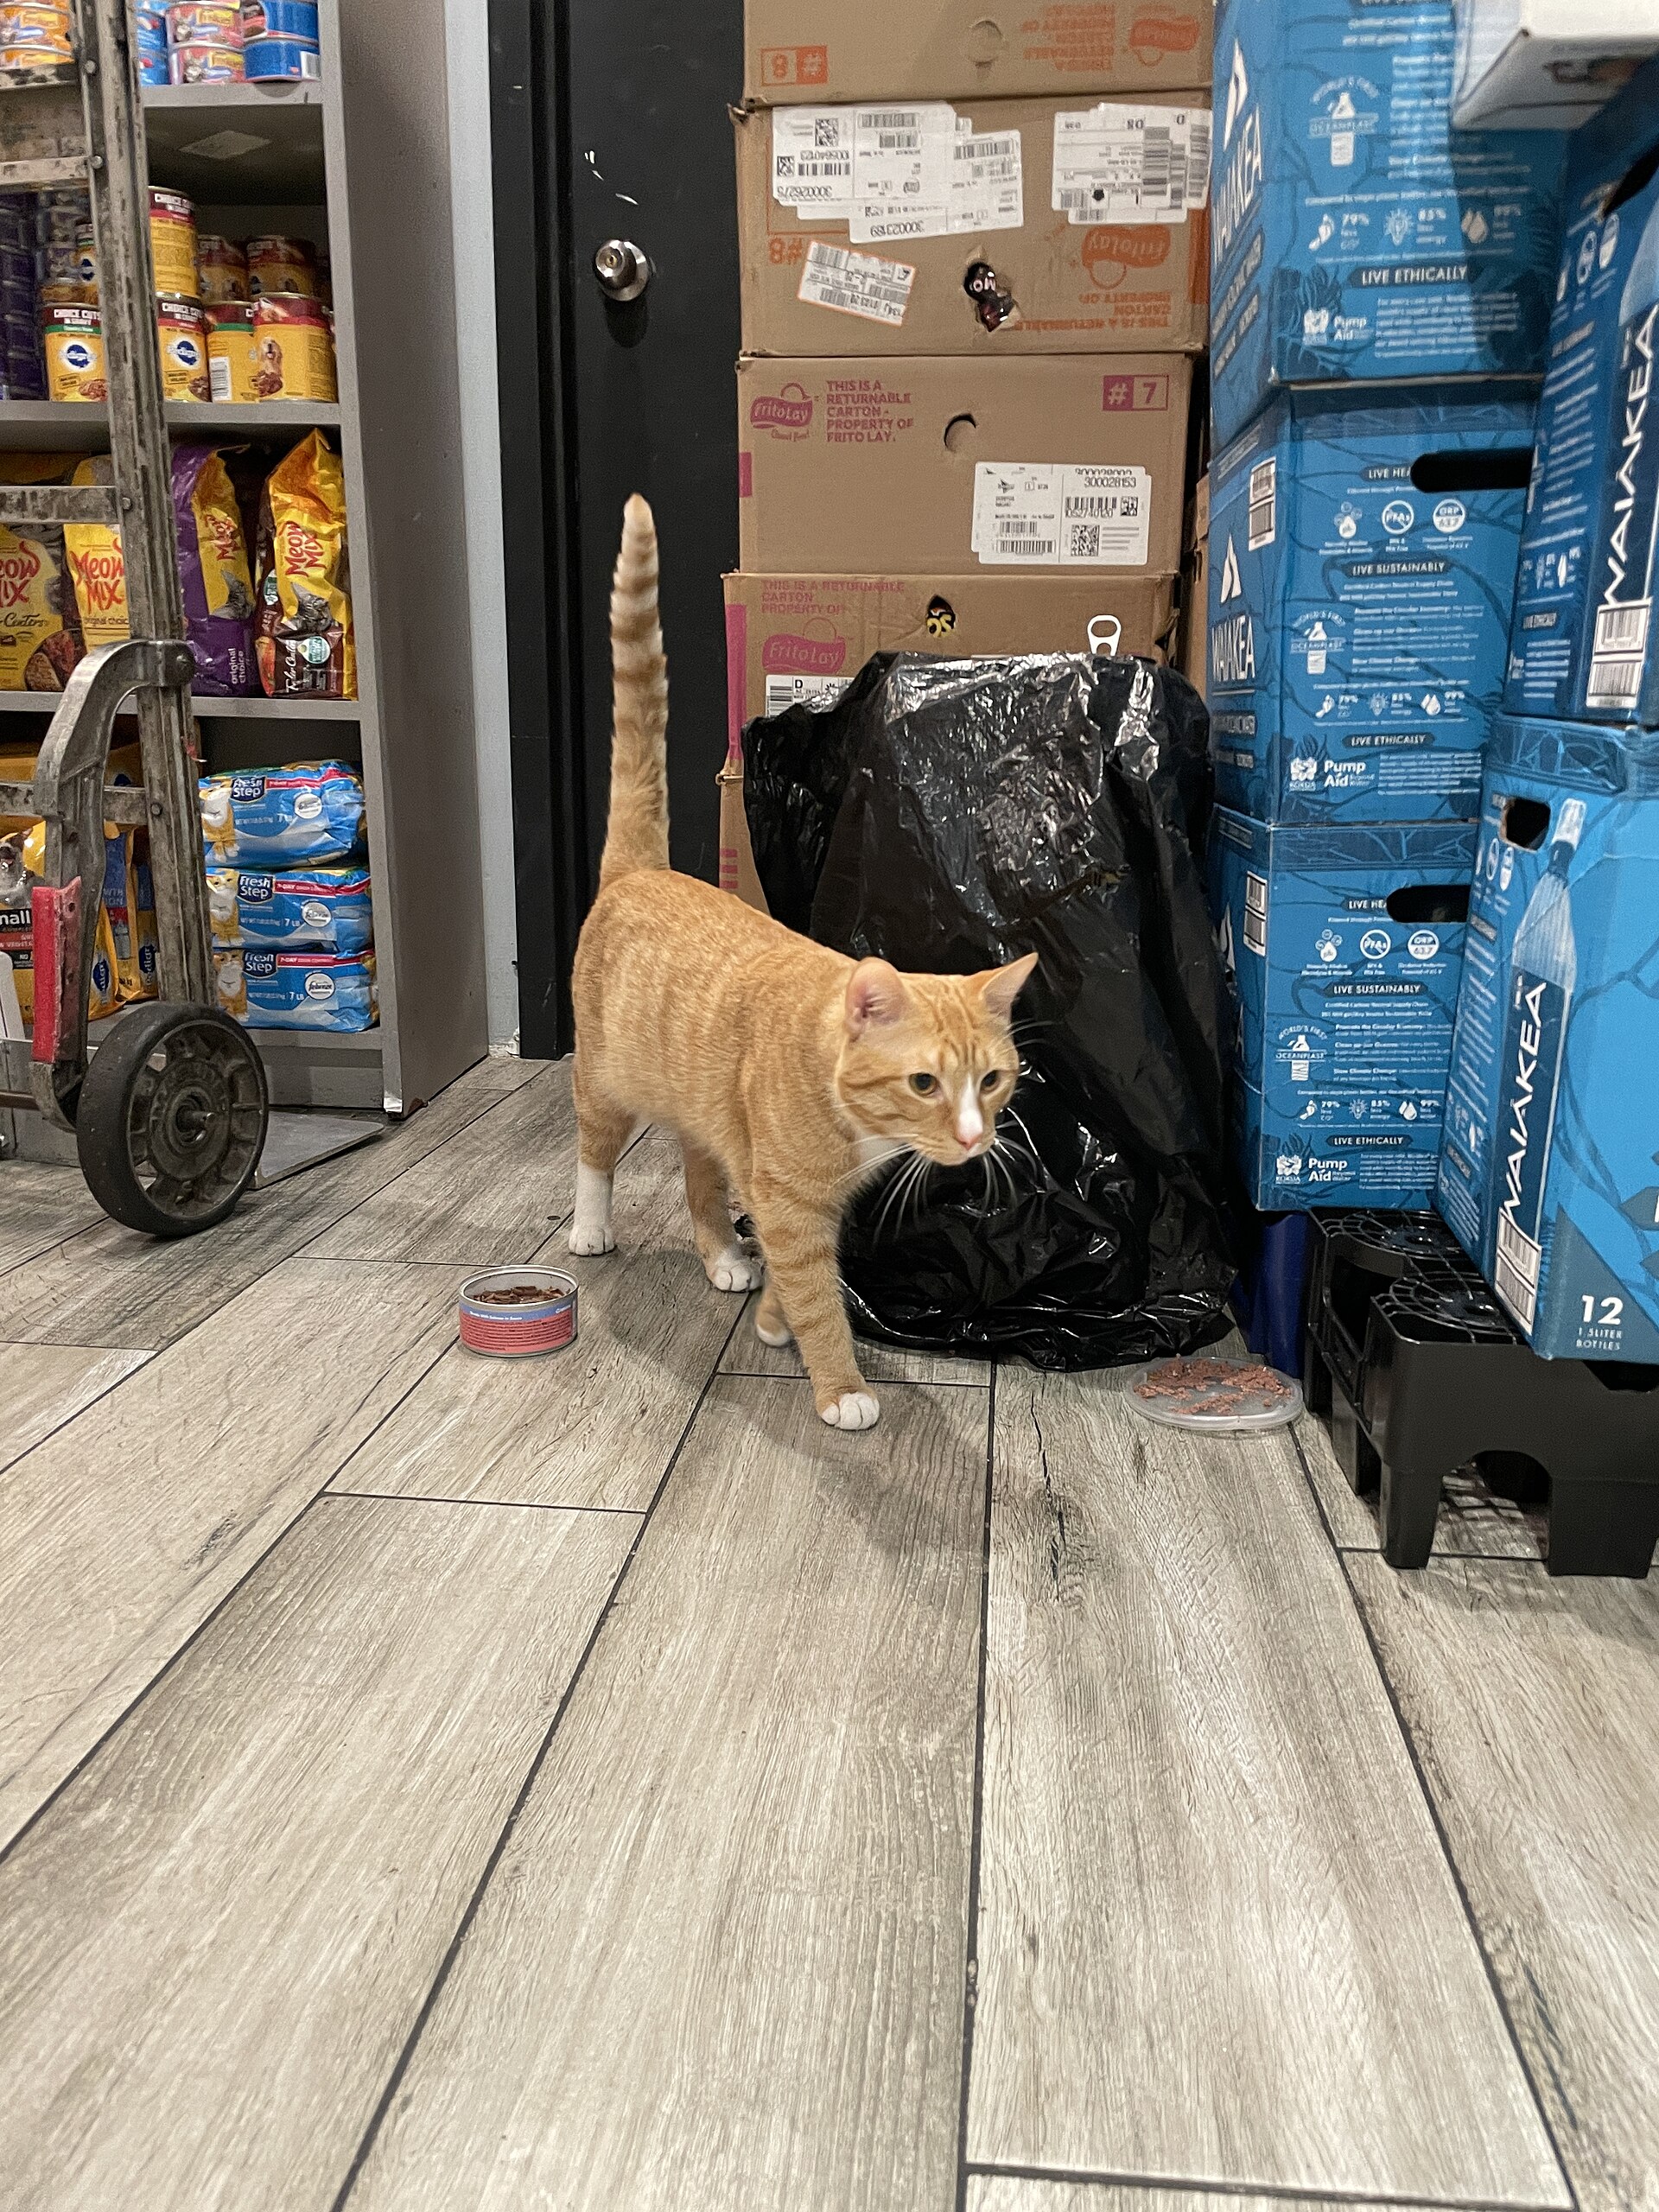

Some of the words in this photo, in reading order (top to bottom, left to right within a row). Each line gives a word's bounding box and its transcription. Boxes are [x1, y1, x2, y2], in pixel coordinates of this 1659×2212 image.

[1361, 268, 1389, 285] LIVE
[1394, 265, 1468, 283] ETHICALLY
[826, 380, 857, 392] THIS
[858, 380, 871, 391] IS
[873, 380, 883, 391] A
[826, 392, 912, 405] RETURNABLE
[826, 406, 881, 417] CARTON
[826, 418, 893, 430] PROPERTY
[826, 431, 864, 443] FRITO
[1368, 469, 1389, 480] LIVE
[1352, 565, 1373, 575] LIVE
[1376, 562, 1446, 575] SUSTAINABLY
[1351, 736, 1372, 747] LIVE
[1374, 734, 1426, 746] ETHICALLY
[1324, 760, 1367, 774] Pump
[1324, 772, 1349, 787] Aid
[232, 786, 261, 798] Step
[239, 875, 270, 888] Fresh
[240, 885, 269, 899] Step
[1348, 899, 1368, 910] LIVE
[245, 951, 275, 963] Fresh
[245, 961, 273, 974] Step
[1333, 985, 1353, 995] LIVE
[1356, 984, 1421, 995] SUSTAINABLY
[1334, 1137, 1353, 1146] LIVE
[1355, 1136, 1404, 1145] ETHICALLY
[1308, 1158, 1348, 1171] Pump
[1308, 1169, 1332, 1182] Aid
[1581, 1294, 1624, 1325] 12
